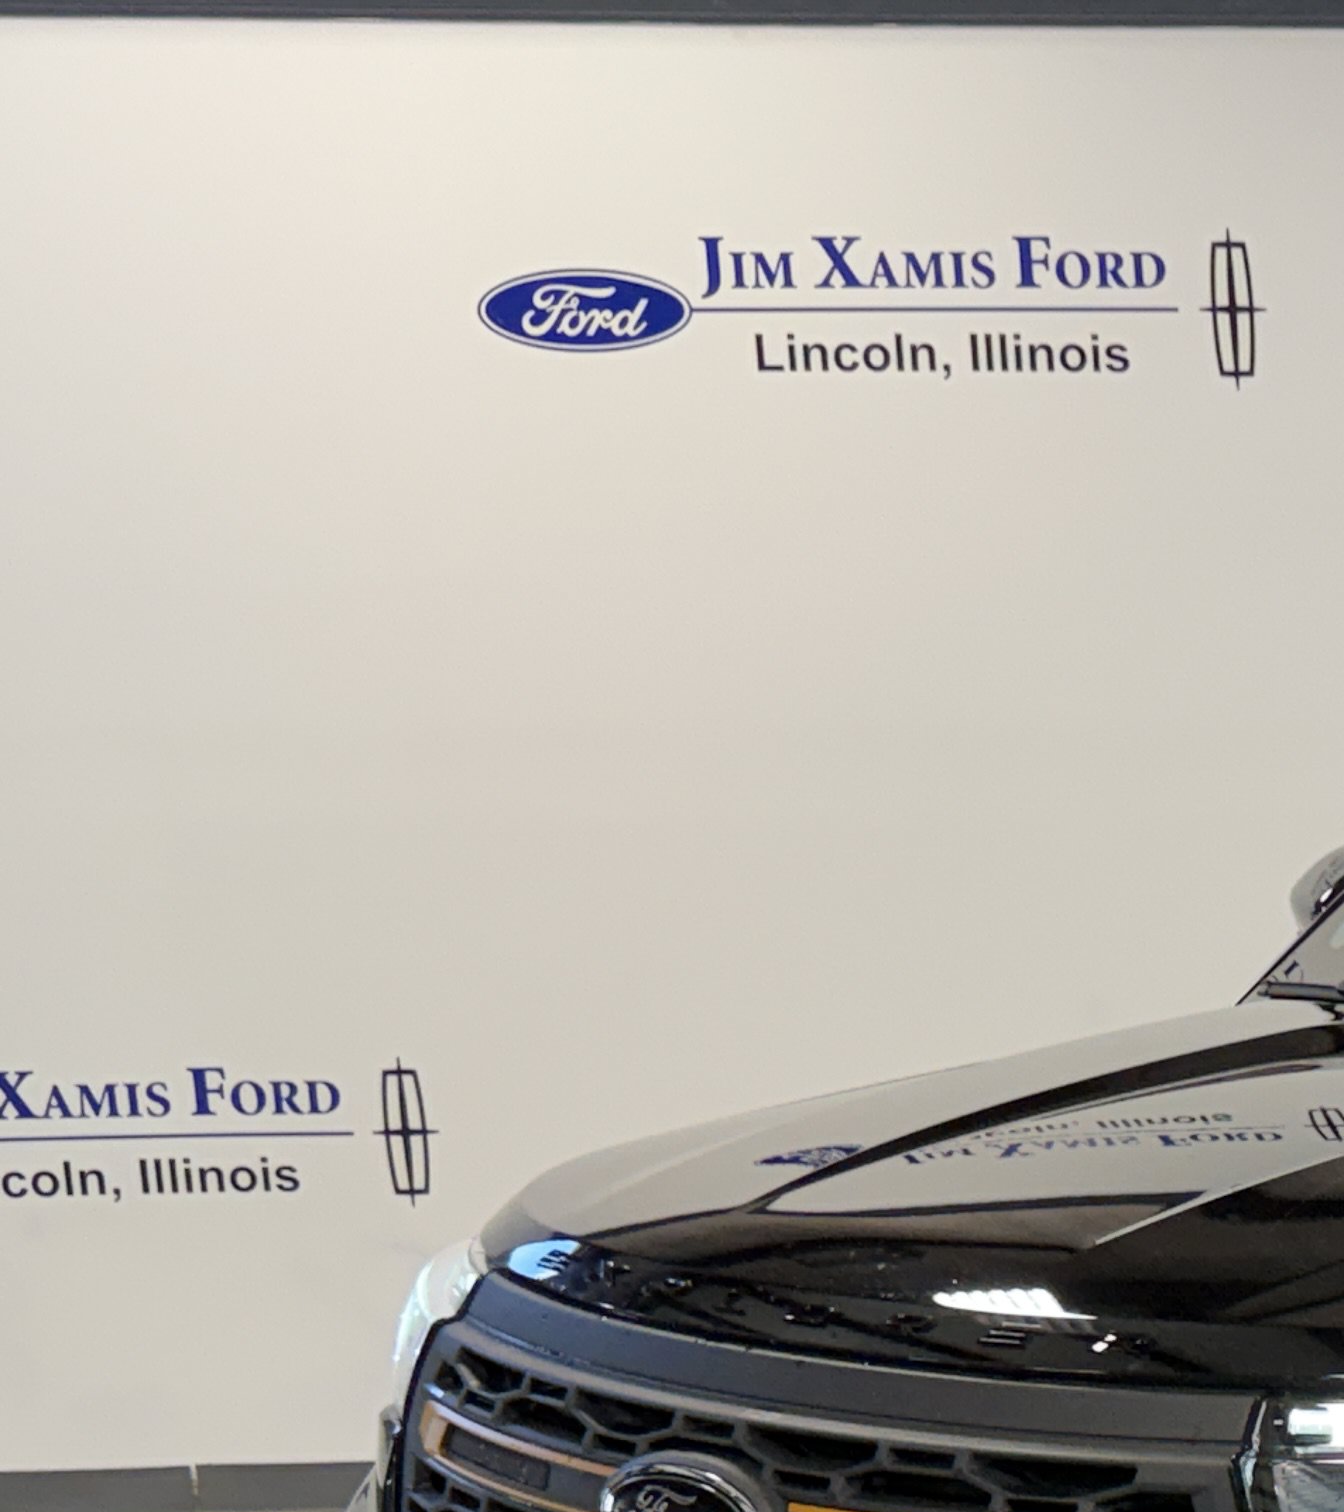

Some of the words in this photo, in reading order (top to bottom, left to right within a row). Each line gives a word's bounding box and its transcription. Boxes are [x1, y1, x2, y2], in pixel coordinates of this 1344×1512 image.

[697, 236, 798, 300] JIM
[811, 235, 997, 291] XAMIS
[1011, 235, 1167, 290] FORD
[521, 284, 649, 337] Ford
[754, 332, 952, 381] Lincoln,
[969, 332, 1131, 374] Illinois
[185, 1066, 341, 1117] FORD
[138, 1156, 300, 1195] Illinois
